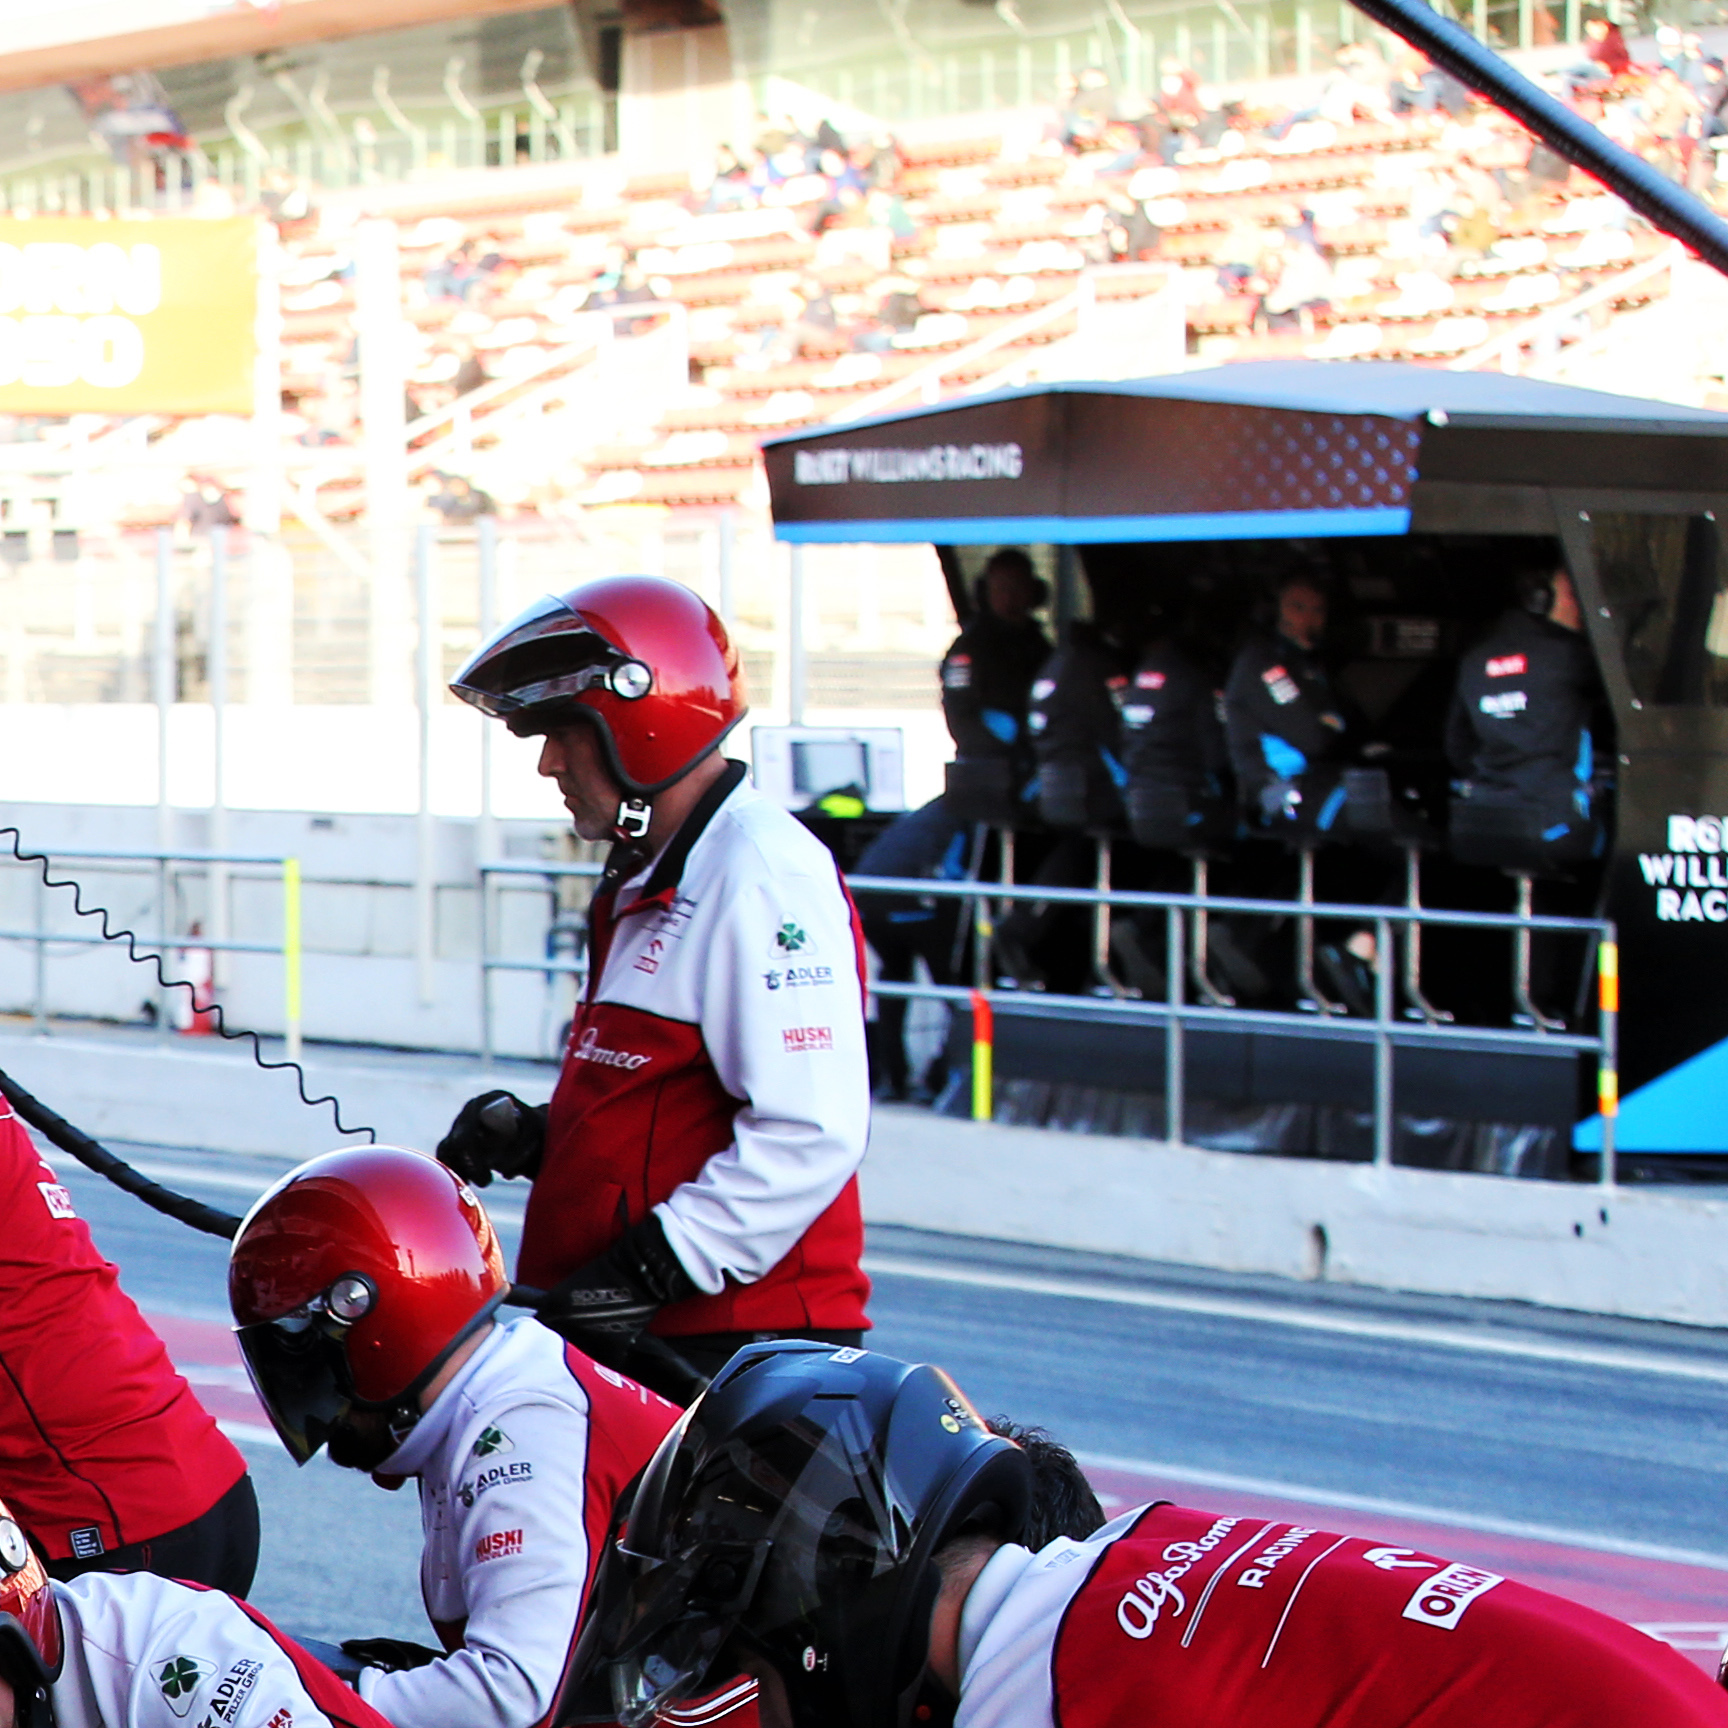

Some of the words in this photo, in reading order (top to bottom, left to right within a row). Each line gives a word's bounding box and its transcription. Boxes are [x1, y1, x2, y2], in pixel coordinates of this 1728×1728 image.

[1667, 814, 1728, 854] RO
[1637, 853, 1728, 888] WILL
[1656, 888, 1728, 922] RAC
[782, 1027, 833, 1043] HUSKI
[477, 1462, 532, 1488] ADLER
[1117, 1561, 1190, 1640] Alfa
[1420, 1564, 1492, 1618] ORLEN
[210, 1659, 256, 1718] ADLER
[224, 1688, 246, 1723] PELZER
